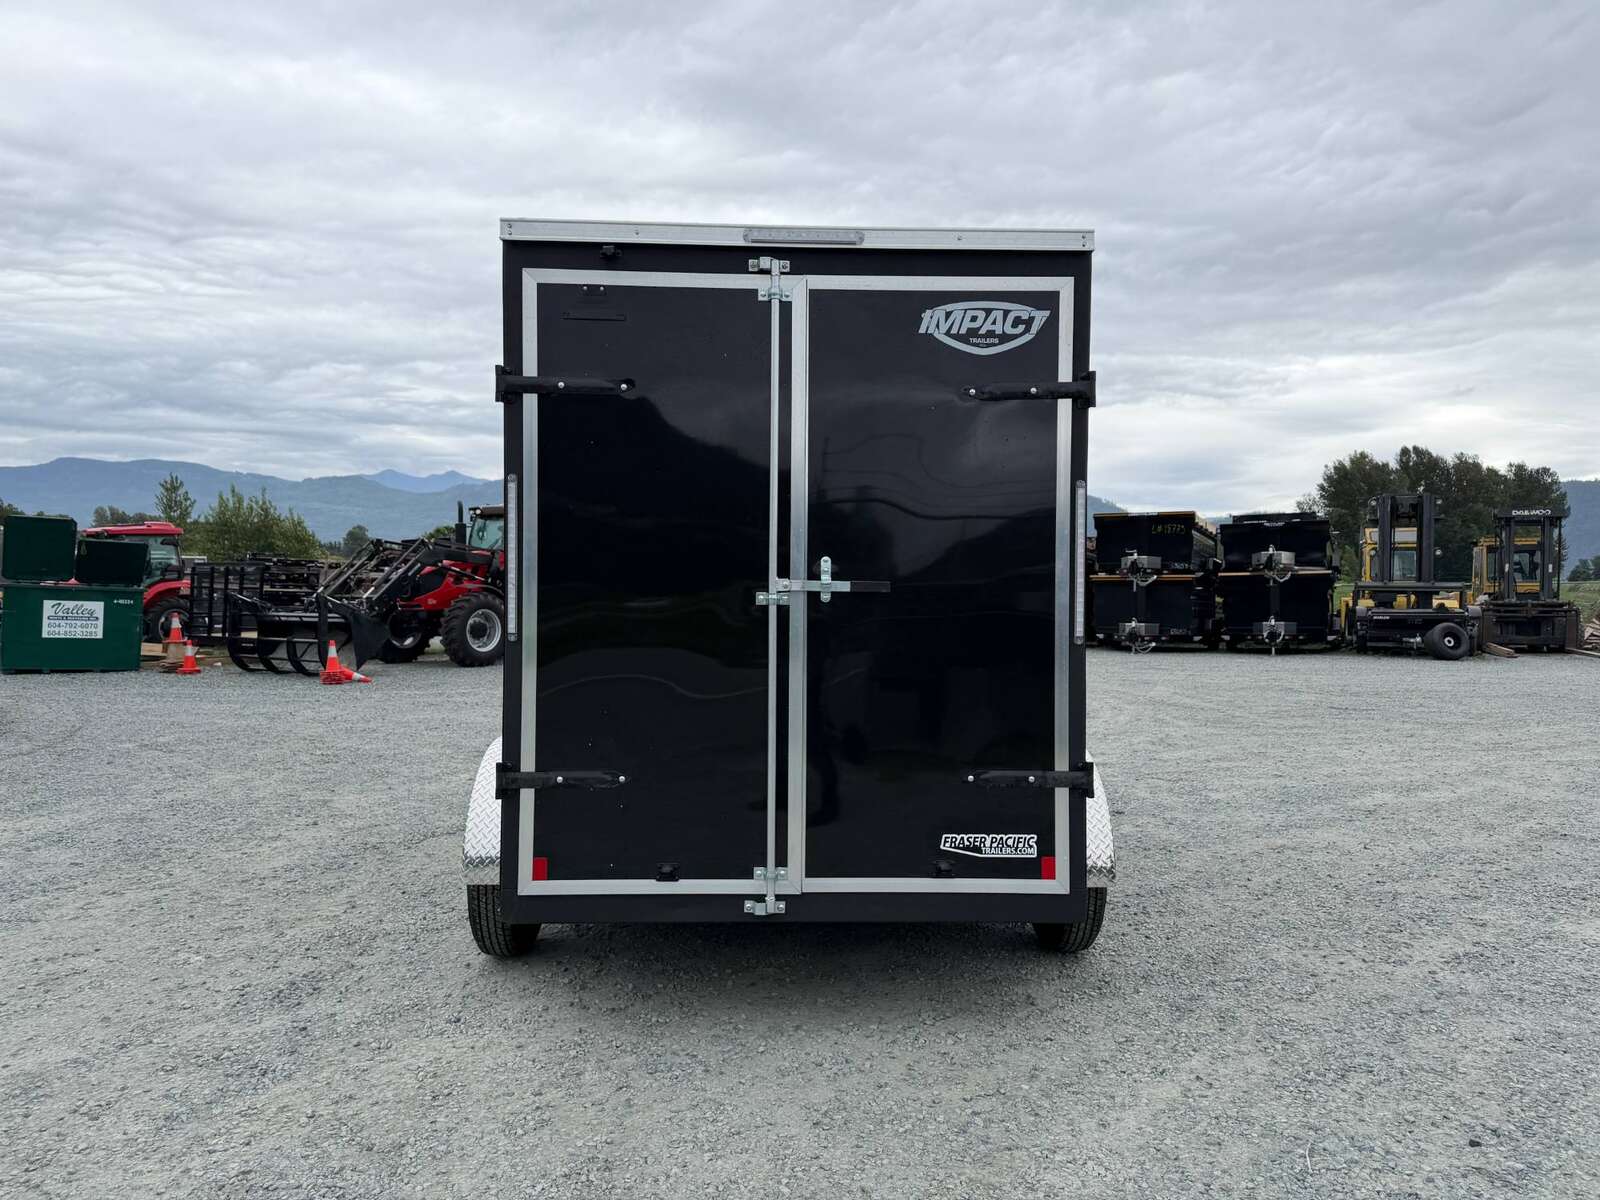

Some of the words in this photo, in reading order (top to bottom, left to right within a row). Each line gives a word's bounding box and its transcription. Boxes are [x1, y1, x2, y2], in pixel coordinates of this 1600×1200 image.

[51, 602, 97, 617] Valley
[943, 835, 987, 848] FRASER
[990, 835, 1036, 848] PACIFIC
[981, 847, 1035, 855] TRAILERS.COM
